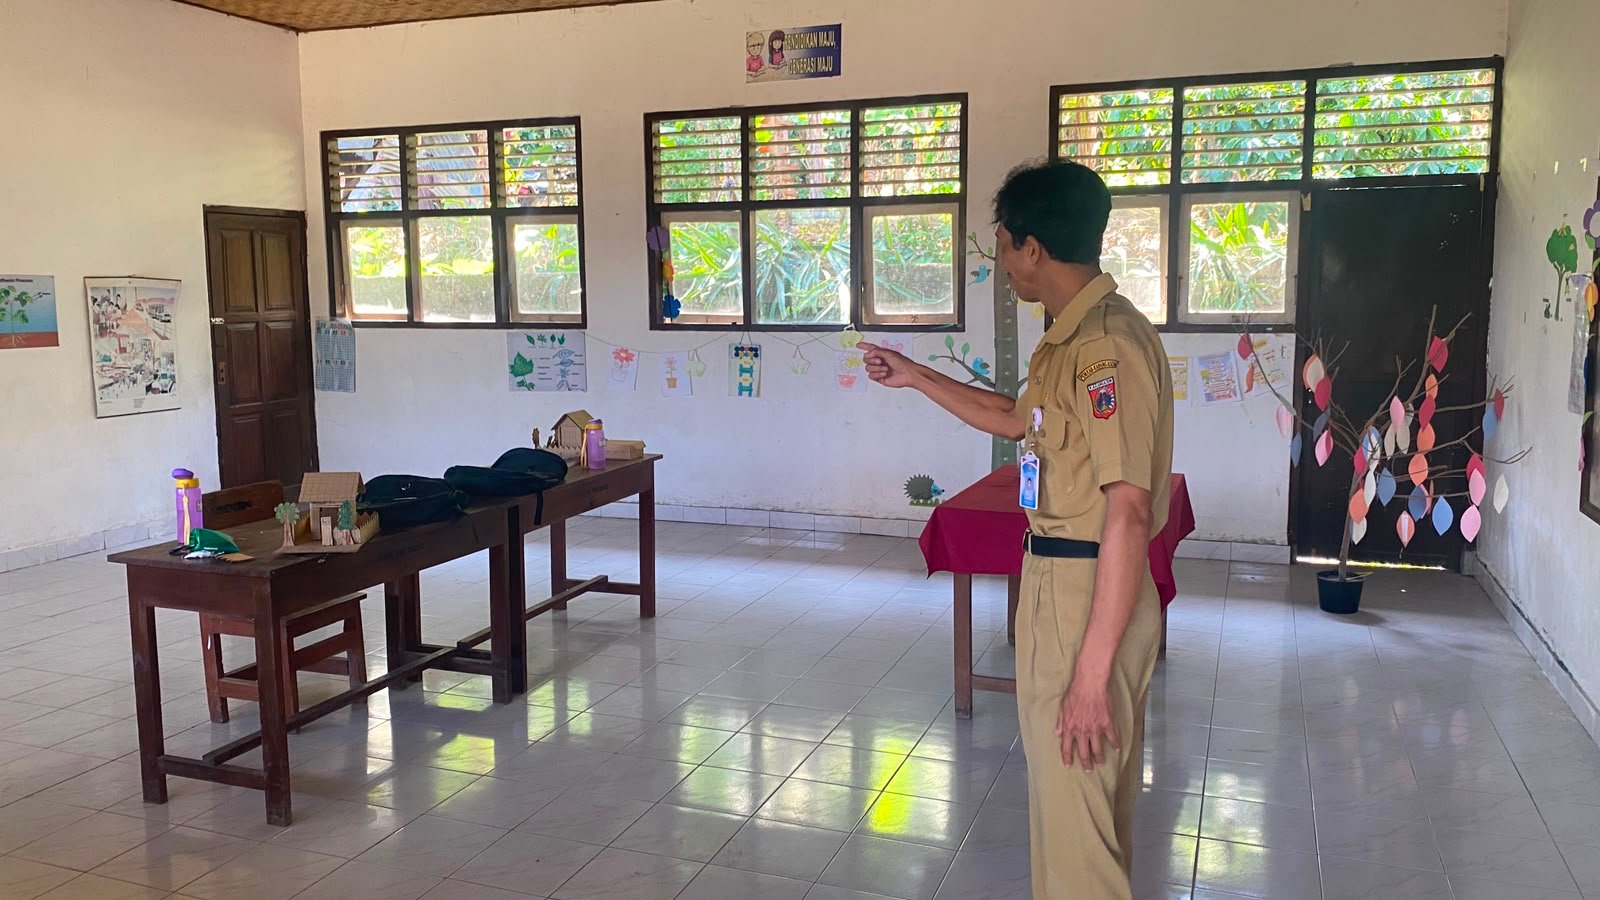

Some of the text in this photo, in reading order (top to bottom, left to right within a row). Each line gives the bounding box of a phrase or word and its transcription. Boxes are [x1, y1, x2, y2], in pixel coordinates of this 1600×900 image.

[784, 32, 818, 51] PENDIDIKAN
[789, 56, 833, 75] GENERASI MAJU
